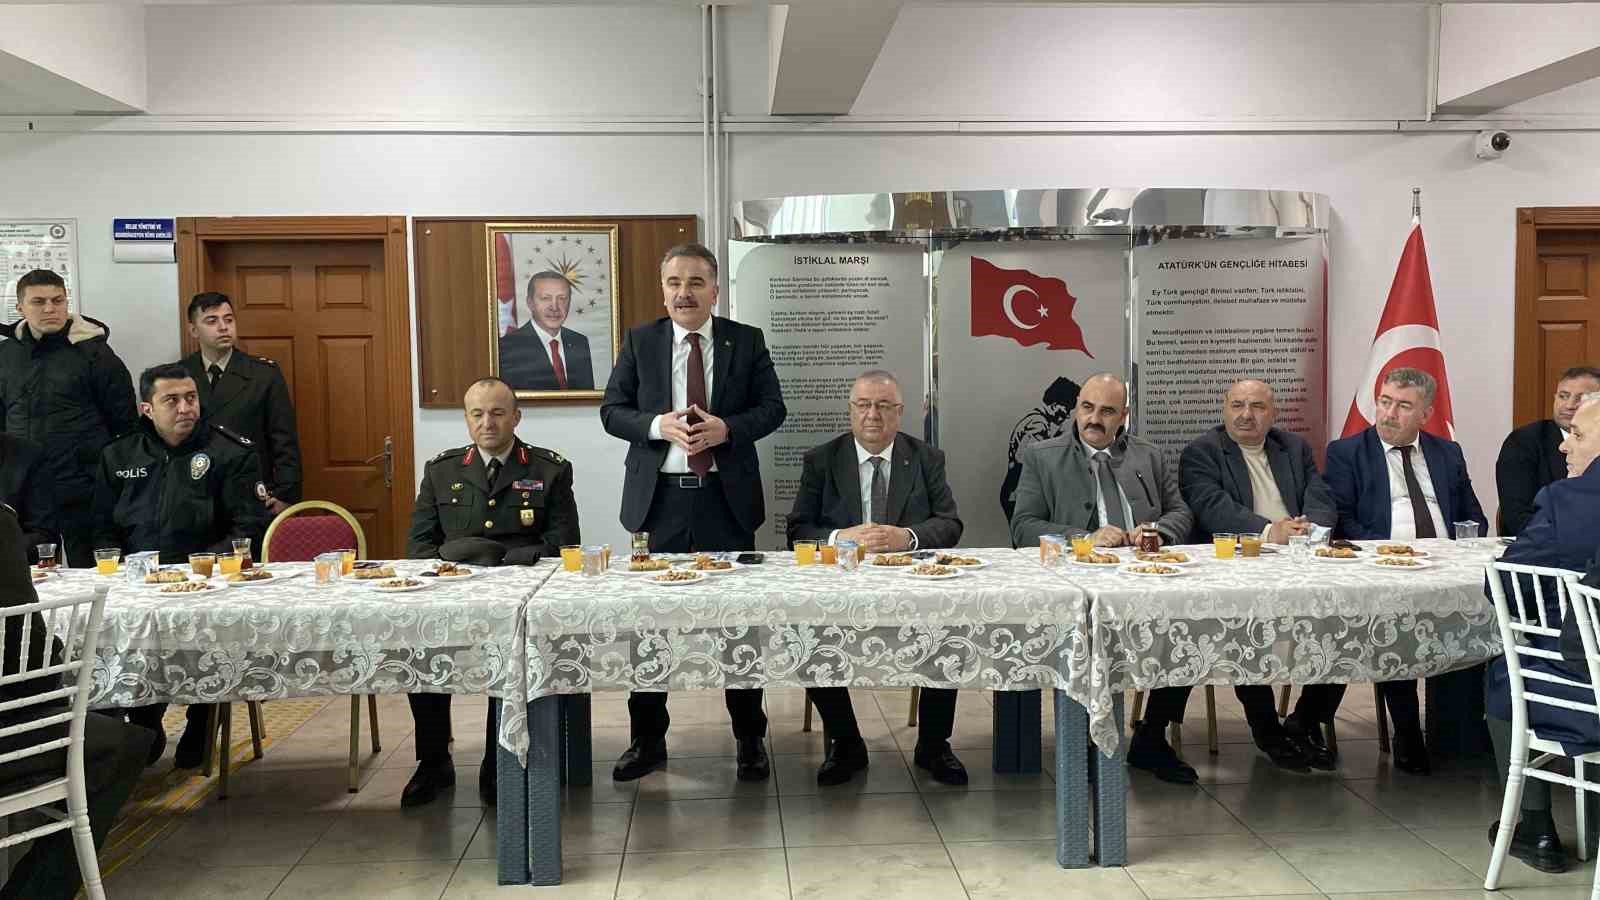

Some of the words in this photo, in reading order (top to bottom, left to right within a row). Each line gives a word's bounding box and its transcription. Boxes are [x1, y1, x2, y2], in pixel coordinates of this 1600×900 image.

[793, 255, 837, 265] İSTİKLAL
[838, 255, 869, 267] MARŞI
[1158, 259, 1217, 270] ATATÜRK'ÜN
